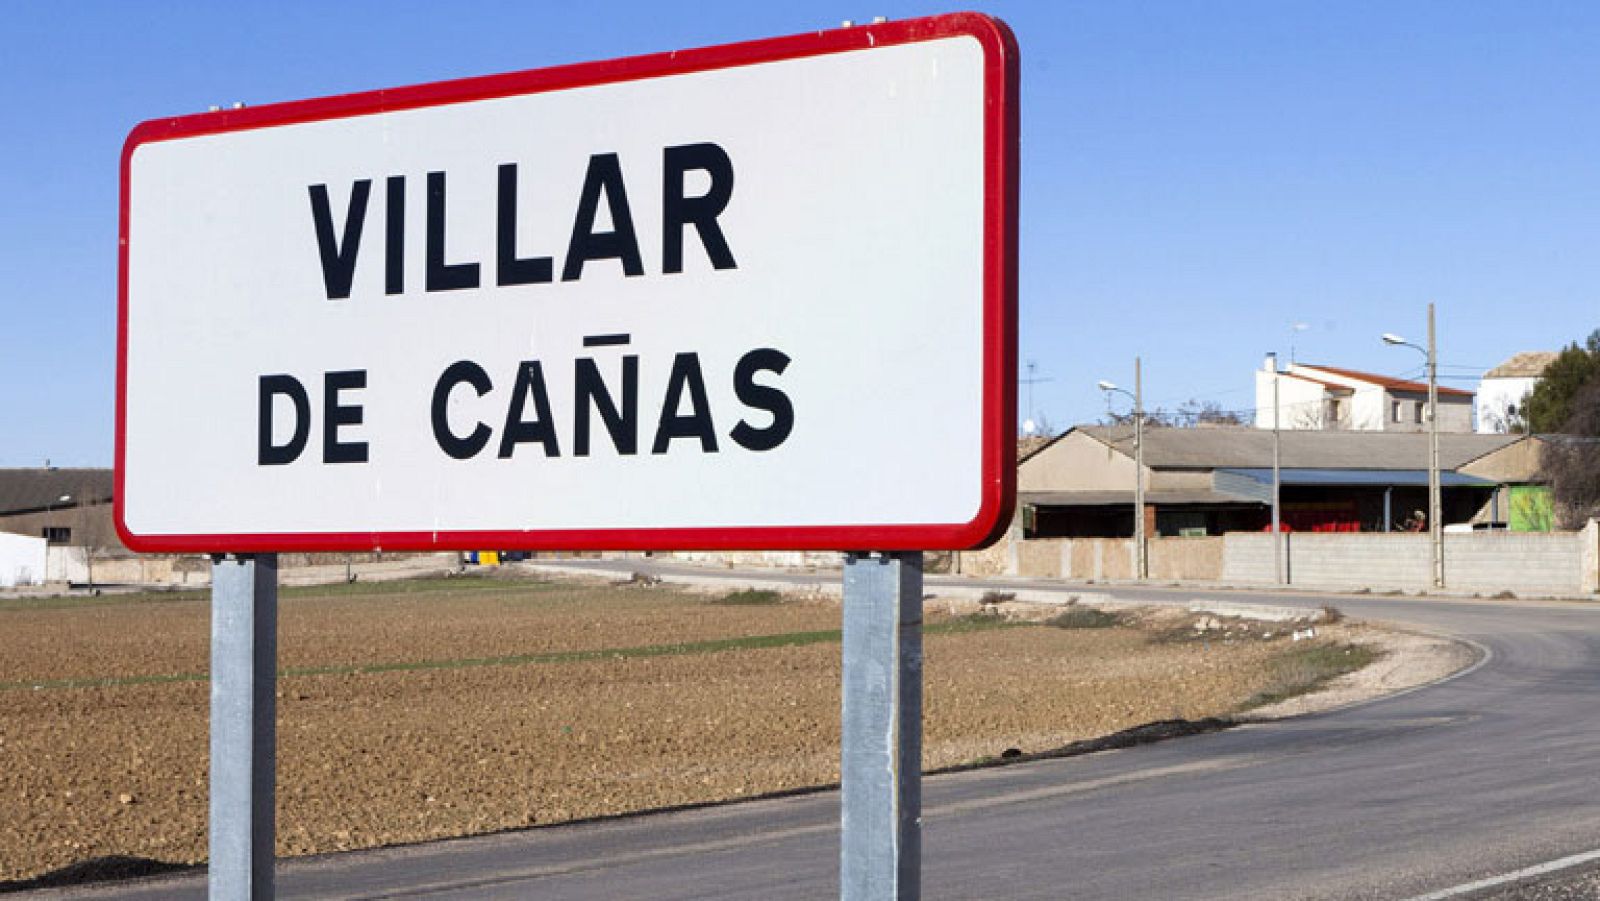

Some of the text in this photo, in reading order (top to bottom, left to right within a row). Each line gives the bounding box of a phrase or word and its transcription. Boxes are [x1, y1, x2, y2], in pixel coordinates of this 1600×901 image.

[308, 142, 737, 300] VILLAR
[257, 333, 795, 466] DE CAÑAS
